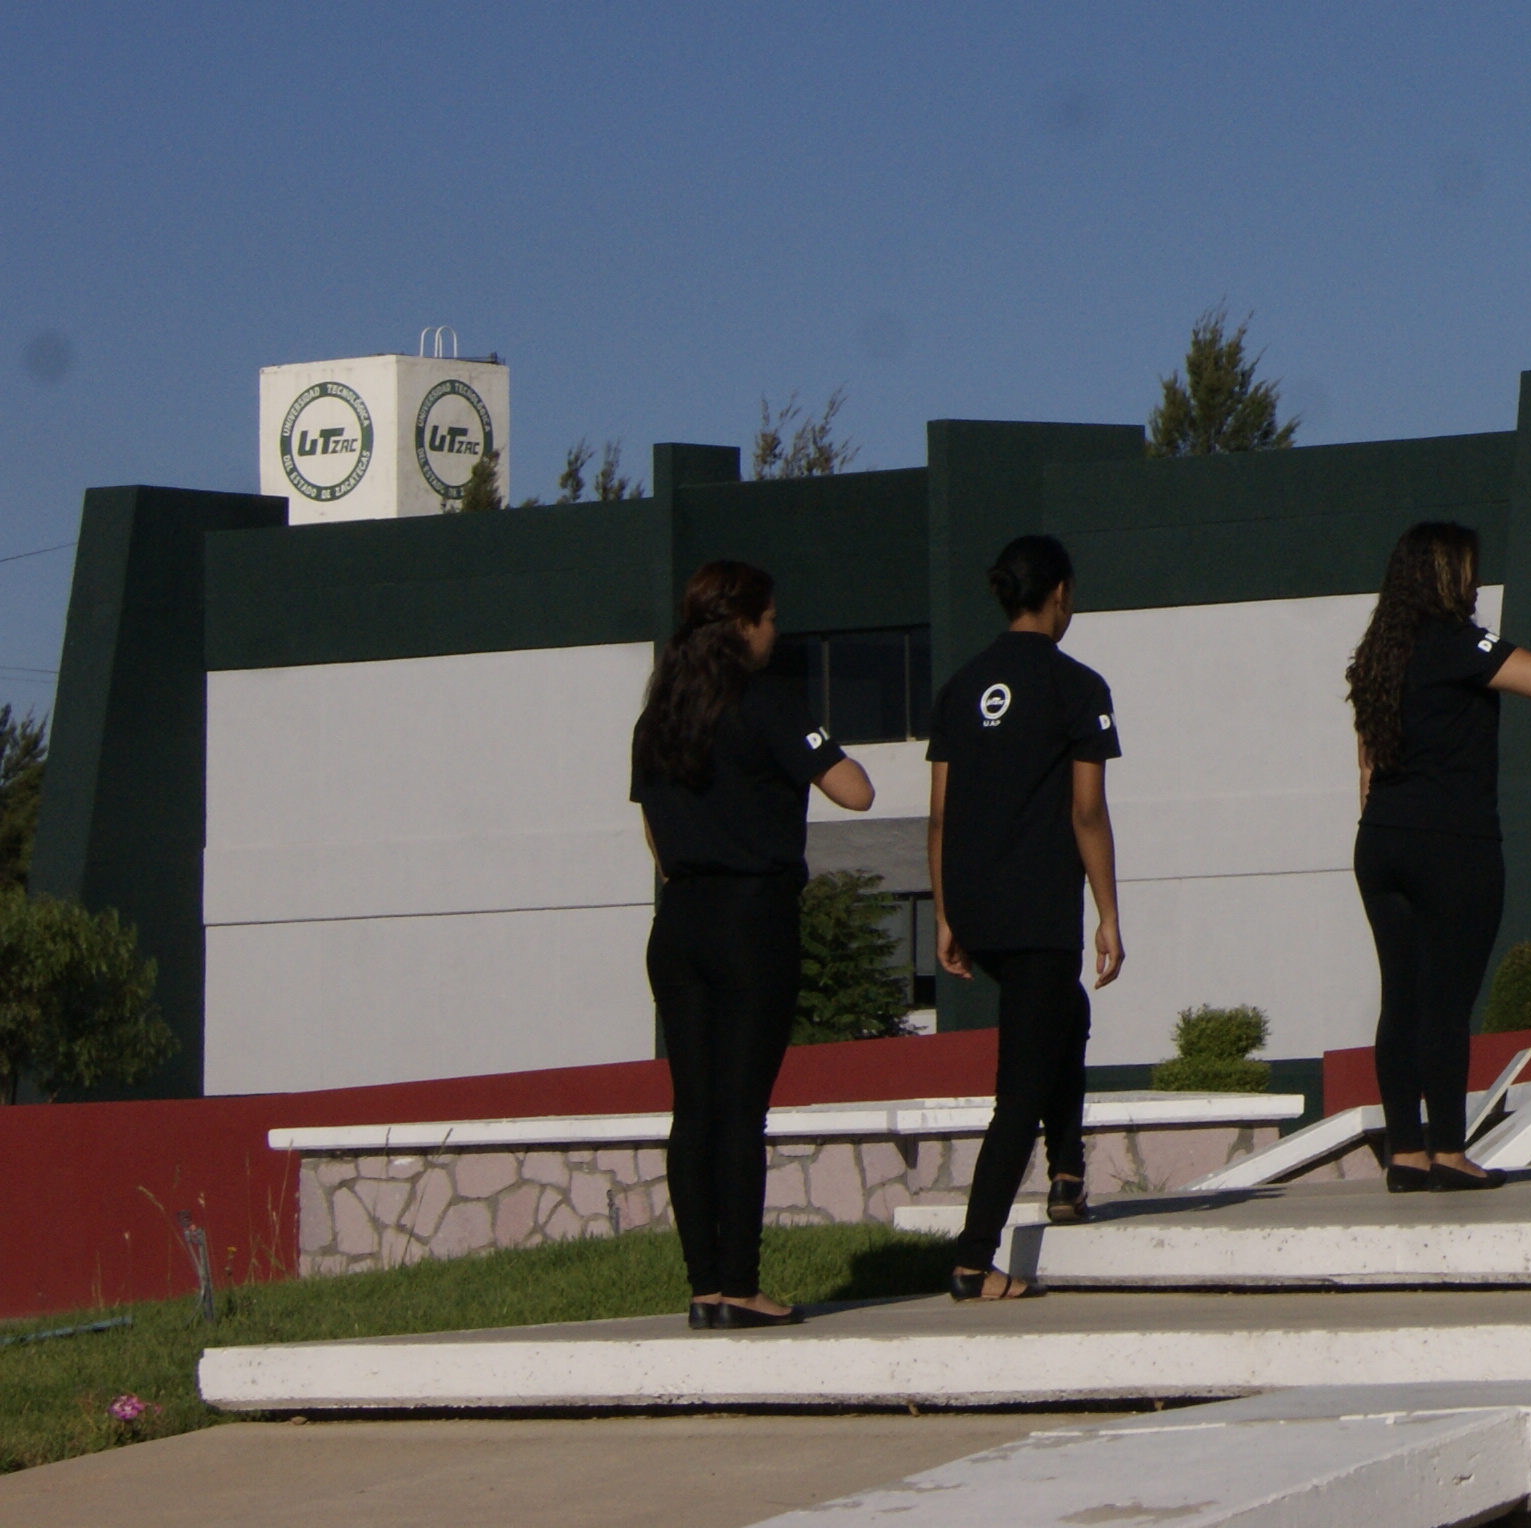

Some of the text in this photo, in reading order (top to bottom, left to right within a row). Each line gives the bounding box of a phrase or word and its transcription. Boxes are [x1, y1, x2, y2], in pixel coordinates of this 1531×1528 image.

[282, 387, 320, 437] UNIVERSIDAD
[283, 454, 293, 472] DEL
[290, 472, 317, 498] ESTADO
[335, 450, 371, 496] ZACATECAS
